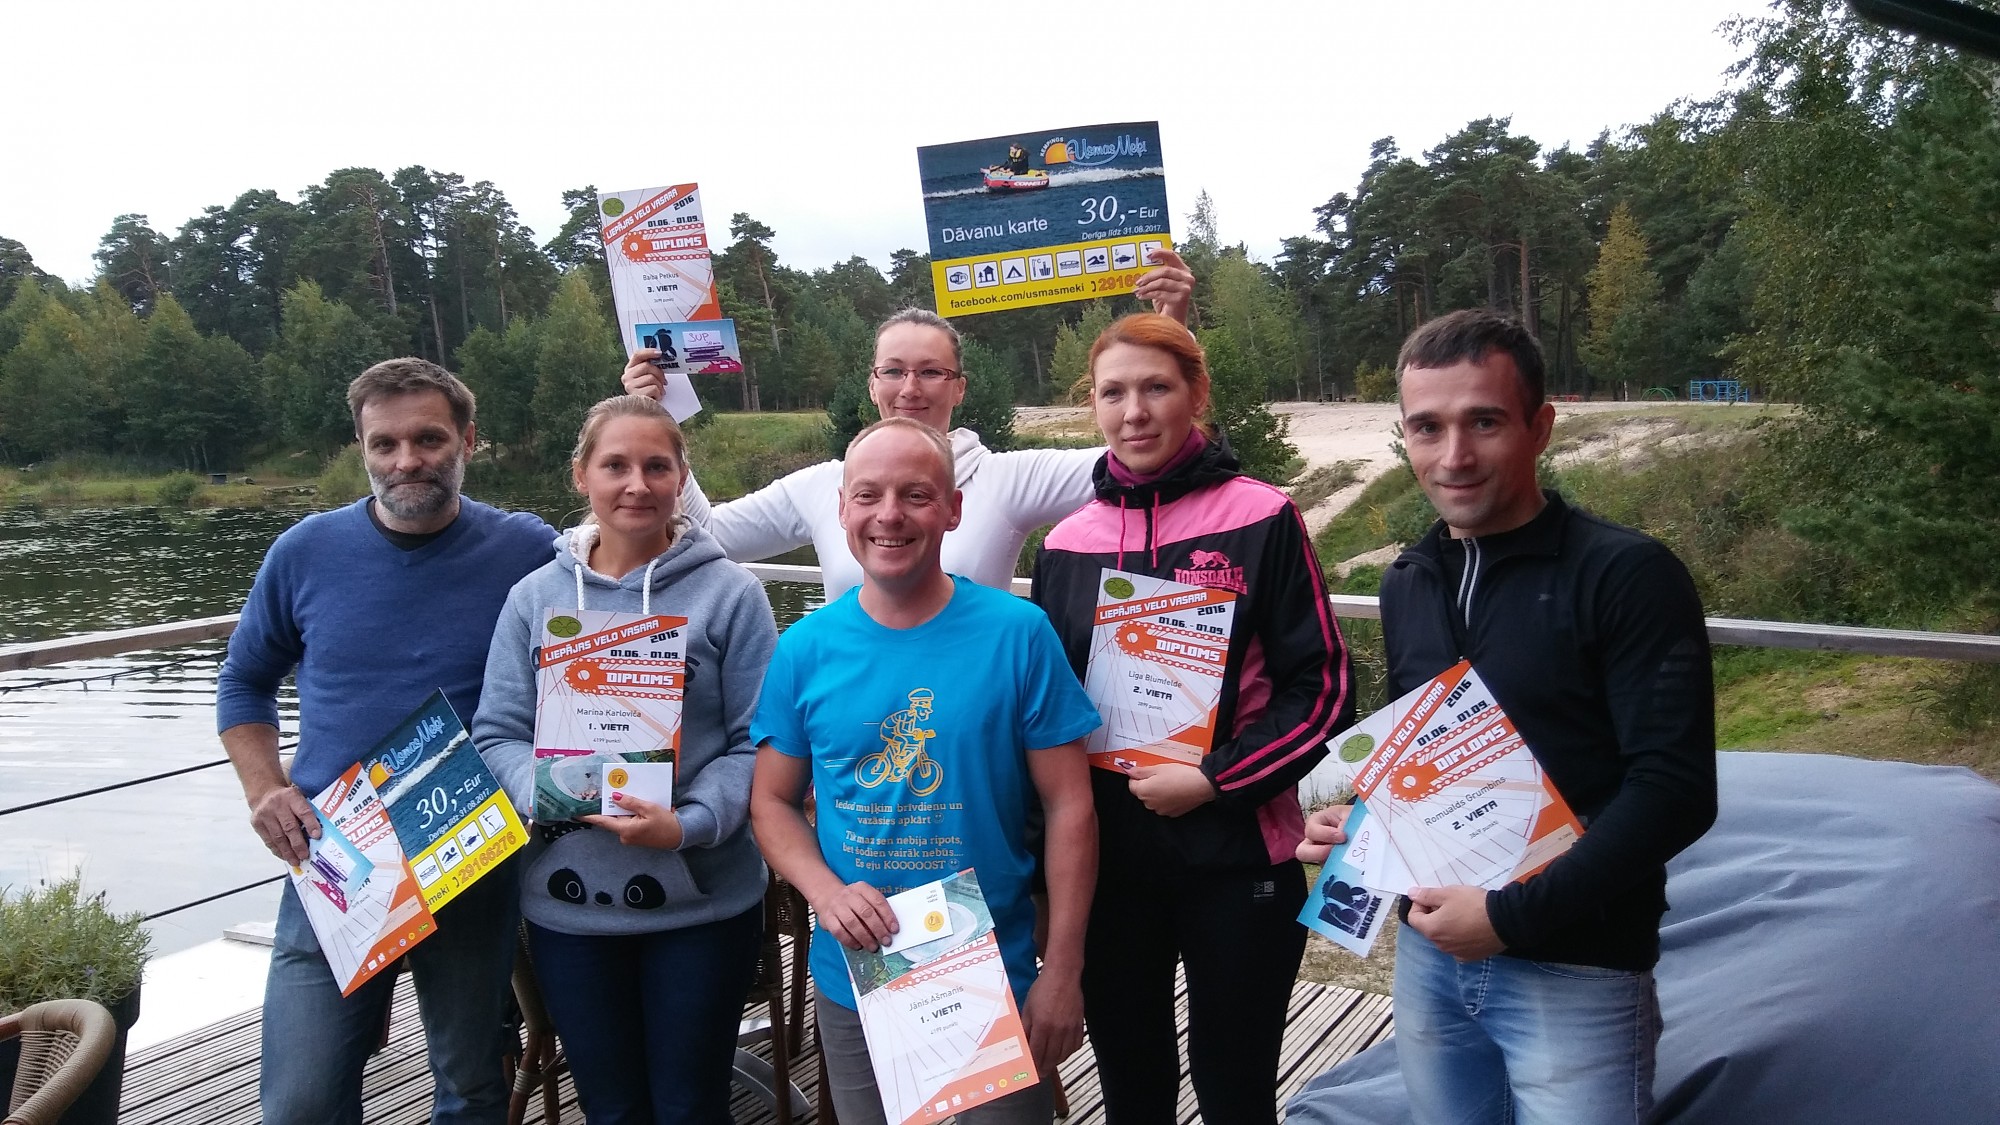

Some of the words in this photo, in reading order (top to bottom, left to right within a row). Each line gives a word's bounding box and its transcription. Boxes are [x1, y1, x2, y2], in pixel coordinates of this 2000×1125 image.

[1040, 136, 1064, 157] KEMPINGS
[1066, 139, 1116, 163] Usmas
[606, 215, 634, 239] LIEPĀJAS
[634, 206, 651, 220] VELO
[651, 188, 678, 210] VASARA
[673, 195, 694, 211] 2016
[1139, 206, 1159, 219] Eur
[647, 218, 670, 228] 01.06.
[676, 215, 699, 223] 01.09.
[942, 224, 1003, 244] Dāvanu
[1008, 217, 1048, 236] karte
[651, 236, 702, 250] DIPLOMS
[656, 284, 678, 292] VIETA
[950, 283, 1085, 308] facebook.com/usmasmeki
[688, 332, 709, 343] SUP
[1174, 566, 1244, 590] LONSDALE
[1100, 603, 1142, 619] LIEPĀJAS
[1144, 599, 1168, 612] VELO
[1169, 591, 1208, 607] VASARA
[1197, 604, 1226, 616] 2016
[650, 629, 679, 644] 2016
[1158, 616, 1188, 629] 01.06.
[1196, 623, 1226, 636] 01.09.
[545, 640, 592, 662] LIEPĀJAS
[594, 631, 618, 646] VELO
[620, 619, 659, 638] VASARA
[1156, 639, 1220, 662] DIPLOMS
[610, 649, 641, 658] 01.06.
[650, 651, 680, 660] 01.09.
[606, 672, 674, 686] DIPLOMS
[1145, 673, 1183, 688] Blumfelde
[1132, 685, 1142, 694] 2.
[1145, 688, 1173, 701] VIETA
[1444, 679, 1473, 708] 2016
[577, 708, 604, 716] Marina
[600, 723, 630, 731] VIETA
[1416, 724, 1451, 747] 01.06.
[1456, 700, 1491, 723] 01.09.
[1358, 745, 1397, 793] LIEPĀJAS
[1392, 720, 1416, 747] VELO
[1411, 681, 1447, 721] VASARA
[381, 738, 423, 774] Usmas
[1432, 723, 1507, 773] DIPLOMS
[346, 778, 363, 801] 2016
[463, 773, 482, 793] Eur
[324, 780, 347, 814] VASARA
[353, 795, 375, 814] 01.09.
[949, 802, 963, 810] un
[1424, 799, 1466, 827] Romualds
[1465, 776, 1507, 802] Grumbins
[1452, 820, 1465, 831] 2.
[1465, 800, 1498, 822] VIETA
[857, 836, 875, 845] maz
[876, 836, 893, 845] sen
[896, 836, 928, 847] nebija
[930, 836, 963, 847] ripots,
[459, 831, 516, 884] 29166276
[888, 848, 920, 858] vairāk
[855, 858, 864, 868] Es
[866, 861, 881, 871] eju
[883, 860, 946, 871] KOOOOOST
[1356, 895, 1382, 939] WAKEPARK
[909, 998, 930, 1012] Jānis
[930, 985, 964, 1003] Ašmanis
[920, 1015, 929, 1023] 1.
[932, 1002, 962, 1018] VIETA
